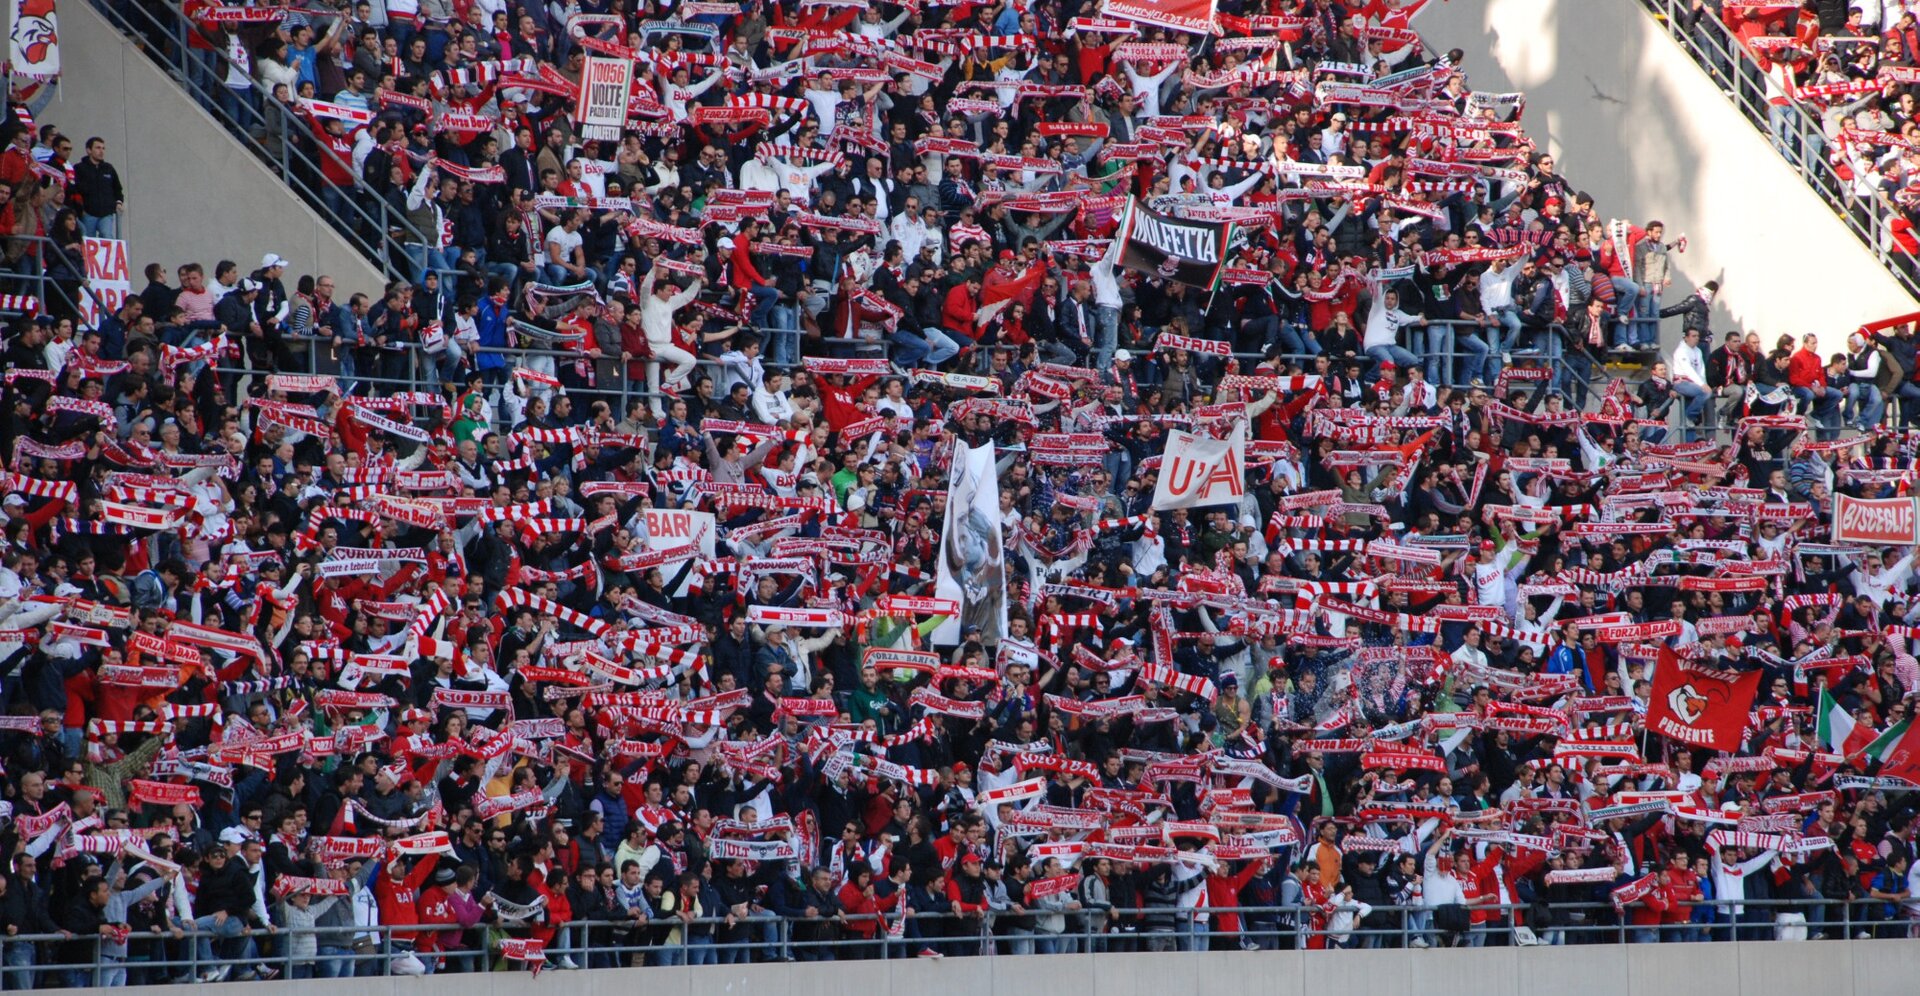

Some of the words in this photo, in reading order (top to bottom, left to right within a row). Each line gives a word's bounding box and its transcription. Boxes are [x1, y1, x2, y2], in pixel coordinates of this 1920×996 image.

[1181, 15, 1208, 31] BARI
[592, 62, 626, 84] 10056
[591, 83, 623, 107] VOLTE
[1132, 212, 1217, 264] MOLFETTA
[1430, 251, 1450, 262] Noi
[1159, 332, 1232, 355] ULTRAS
[952, 374, 983, 385] BARI
[266, 407, 330, 438] ULTRAS
[646, 511, 691, 537] BARI
[1842, 502, 1913, 535] BISCEGLIE
[335, 547, 384, 560] CURVA
[749, 561, 807, 570] MODUGNO
[1478, 570, 1500, 586] BARI
[1327, 598, 1390, 622] BARESI
[1609, 627, 1641, 638] FORZA
[1651, 622, 1675, 633] BARI
[135, 634, 164, 653] FORZA
[175, 648, 201, 662] BARI
[1657, 716, 1715, 744] PRESENTE
[725, 844, 750, 858] ULT
[1232, 836, 1255, 847] ULT
